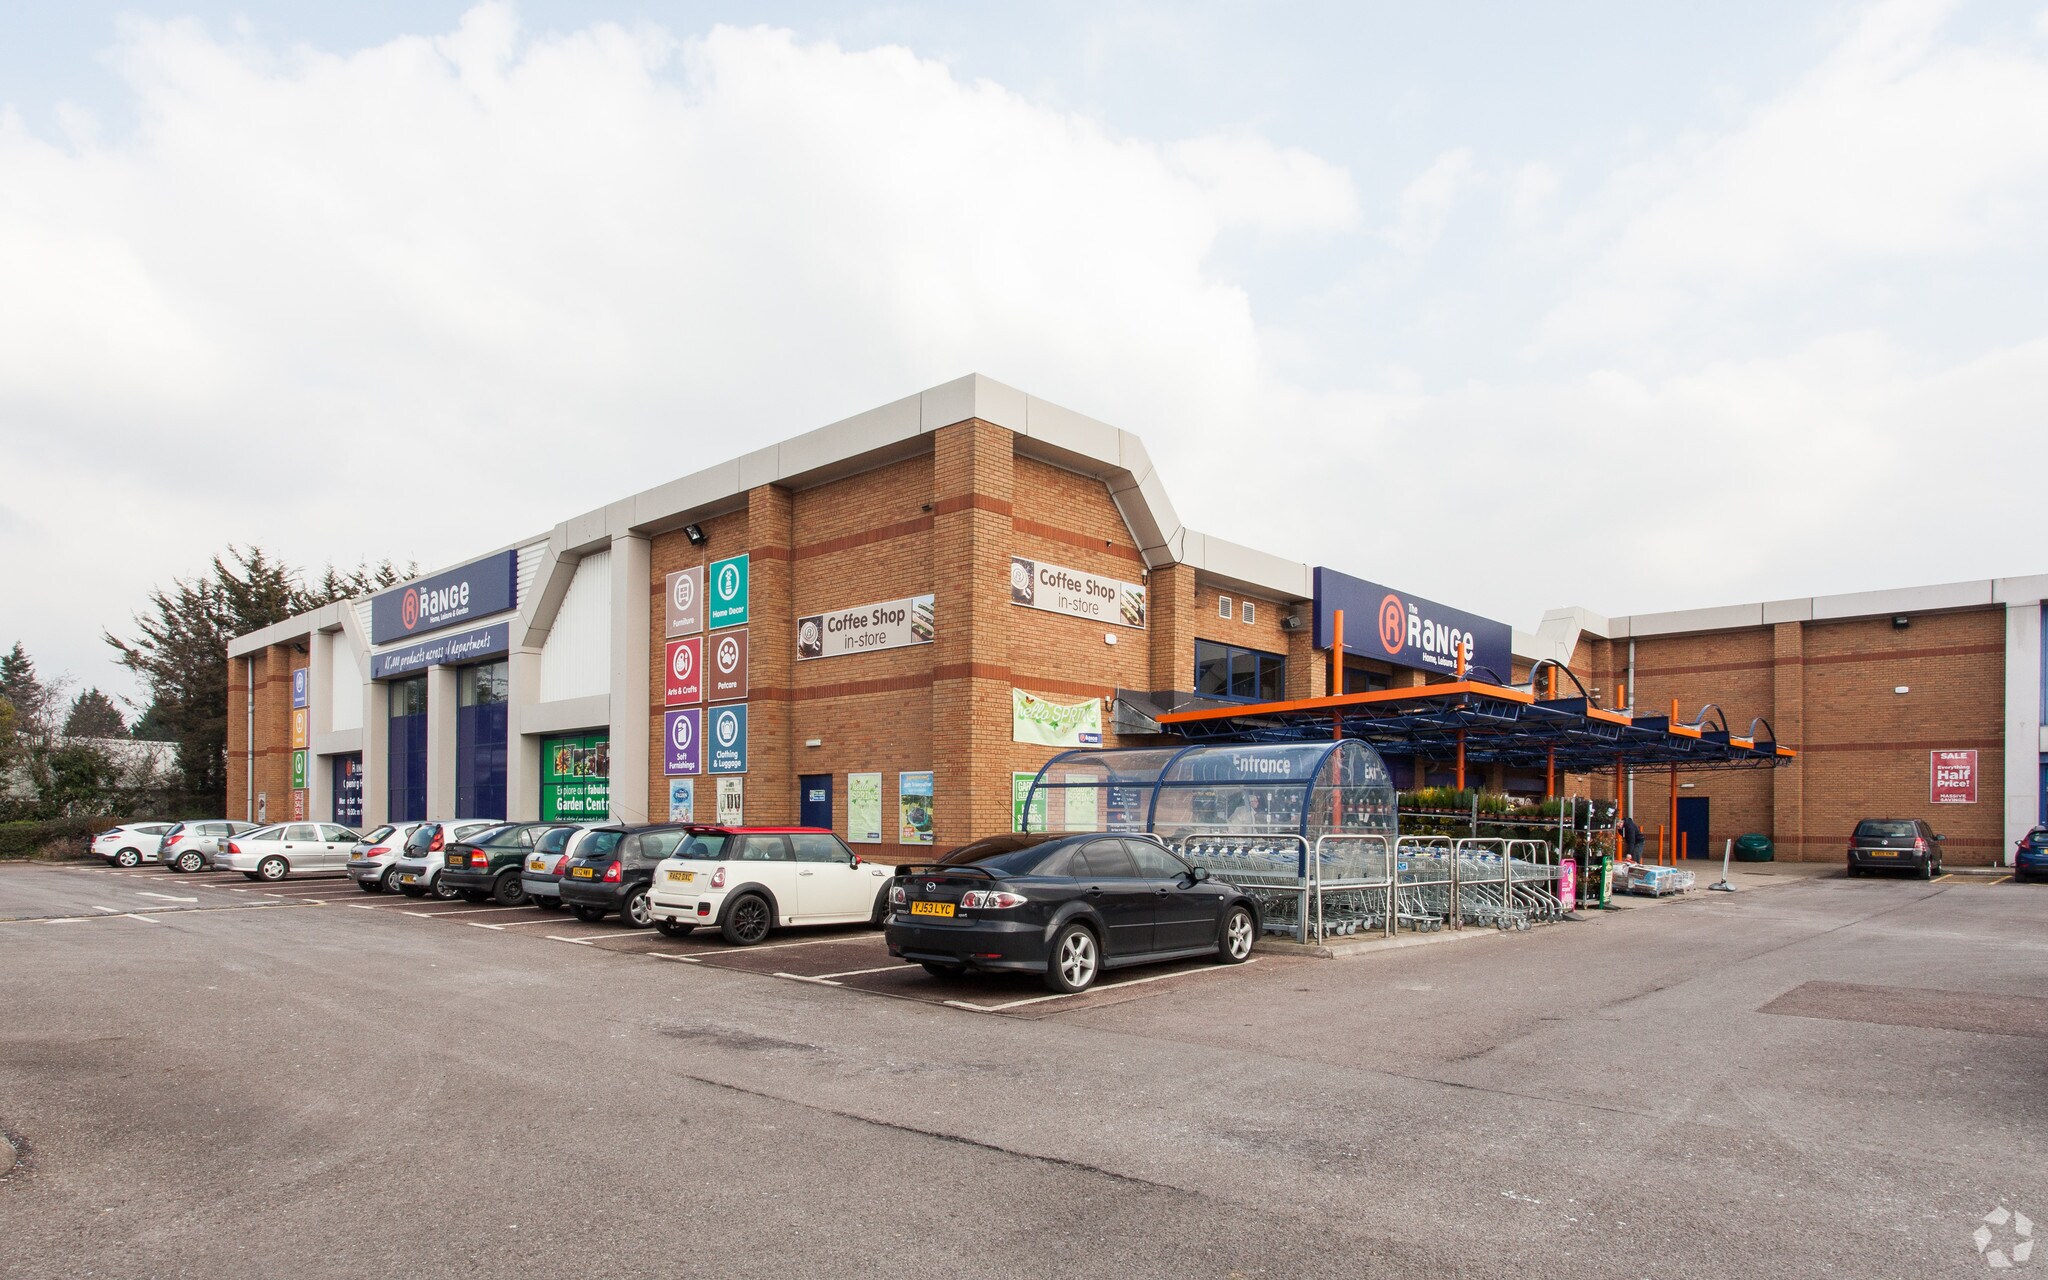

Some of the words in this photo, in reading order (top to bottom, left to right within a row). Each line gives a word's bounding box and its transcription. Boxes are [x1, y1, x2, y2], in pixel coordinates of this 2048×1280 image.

[1040, 569, 1081, 592] Coffee
[1086, 580, 1115, 603] Shop
[1058, 592, 1099, 615] in-store
[1408, 603, 1418, 614] The
[440, 611, 453, 620] Leisure
[456, 607, 469, 616] Garden
[712, 610, 728, 618] Home
[728, 606, 744, 616] Decor
[672, 617, 695, 628] Furniture
[827, 612, 868, 633] Coffee
[872, 608, 906, 626] Shop
[844, 631, 887, 650] in-store
[399, 649, 425, 671] products
[425, 646, 443, 660] across
[451, 631, 490, 658] departments
[1422, 652, 1437, 665] Home,
[1437, 656, 1453, 668] Leisure
[667, 688, 678, 696] Arts
[677, 686, 682, 695] &
[682, 685, 698, 694] Crafts
[717, 681, 738, 690] Petcare
[1015, 701, 1050, 720] hello
[1052, 706, 1097, 723] SPRING
[676, 753, 688, 761] Soft
[716, 750, 739, 760] Clothing
[668, 761, 696, 771] Furnishings
[713, 760, 718, 768] &
[718, 759, 742, 769] Luggage
[1232, 754, 1291, 774] Entrance
[1938, 770, 1970, 779] Half
[556, 785, 577, 797] Explore
[556, 797, 583, 810] Garden
[586, 797, 609, 810] Centr
[914, 902, 933, 914] YJ53
[934, 904, 951, 915] LYC
